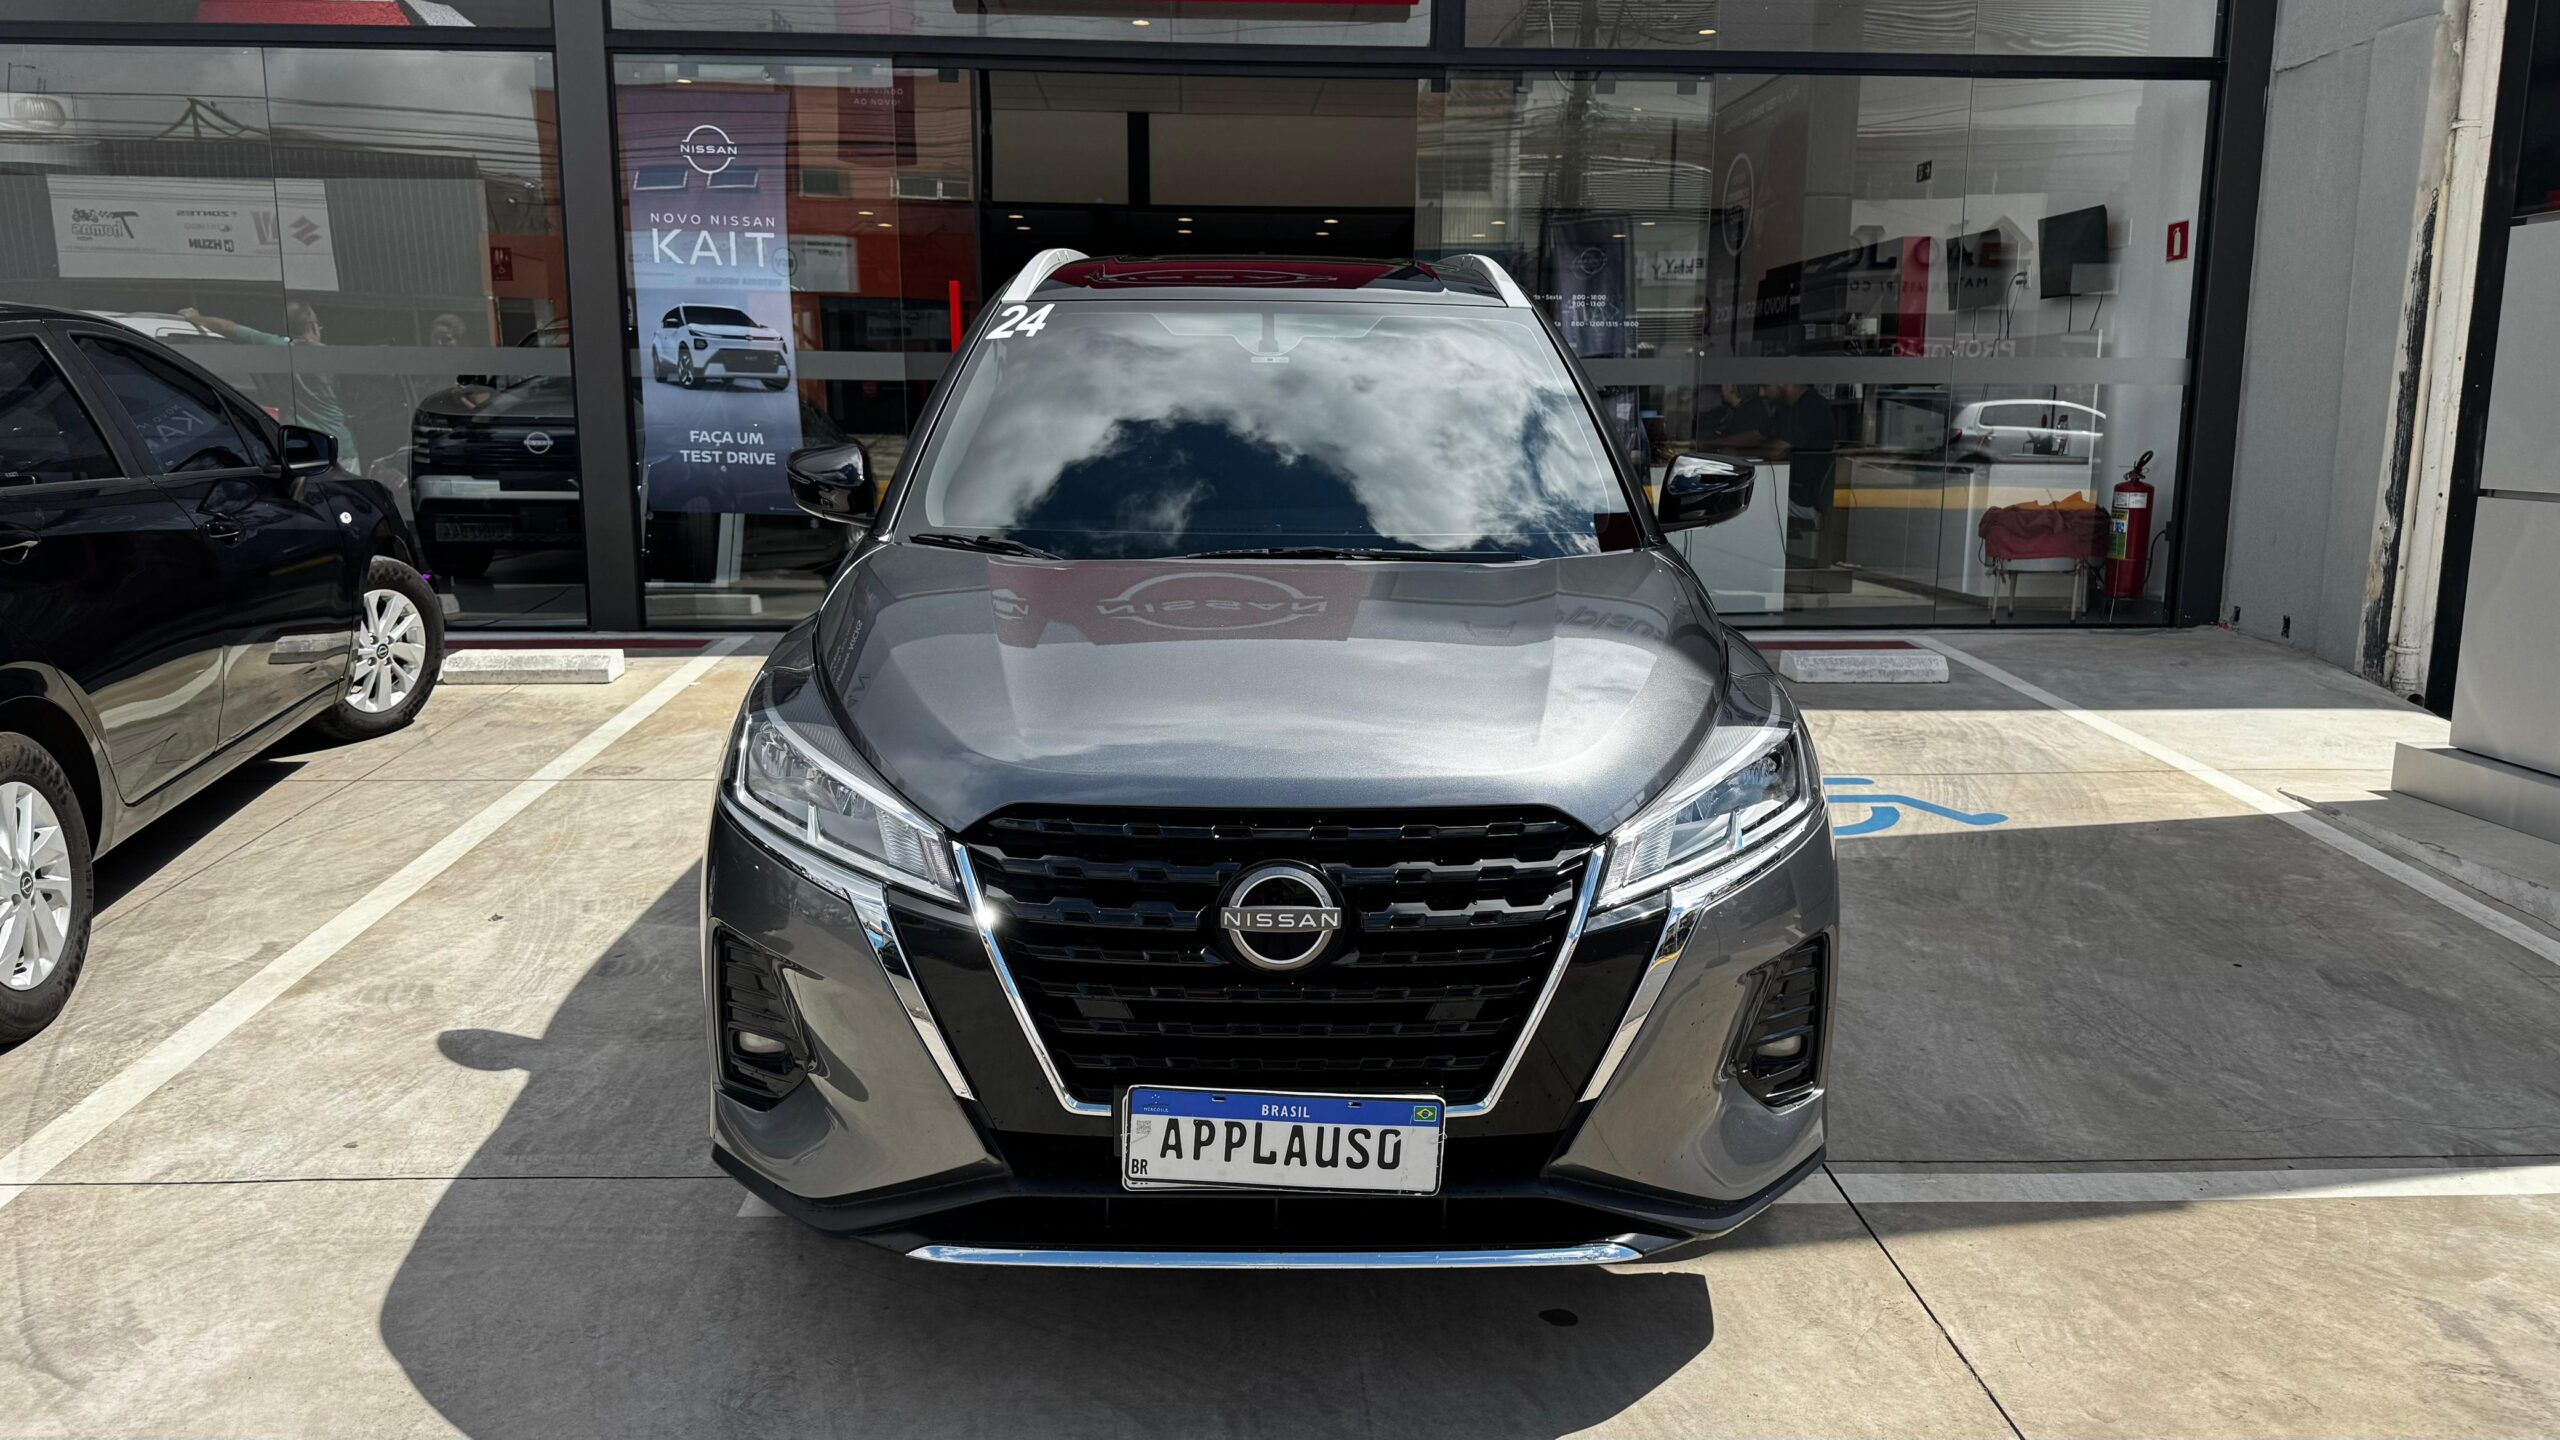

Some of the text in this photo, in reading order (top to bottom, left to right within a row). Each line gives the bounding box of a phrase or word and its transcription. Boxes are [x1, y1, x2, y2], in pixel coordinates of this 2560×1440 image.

[680, 144, 737, 155] NISSAN
[650, 212, 775, 227] NOVO NISSAN
[652, 228, 775, 267] KAIT
[986, 304, 1055, 339] 24
[690, 430, 764, 446] FAÇA UM
[679, 450, 777, 466] TEST DRIVE
[1223, 911, 1338, 928] NISSAN
[1261, 1104, 1311, 1119] BRASIL
[1160, 1117, 1402, 1171] APPLAUSO
[1131, 1158, 1149, 1175] BR
